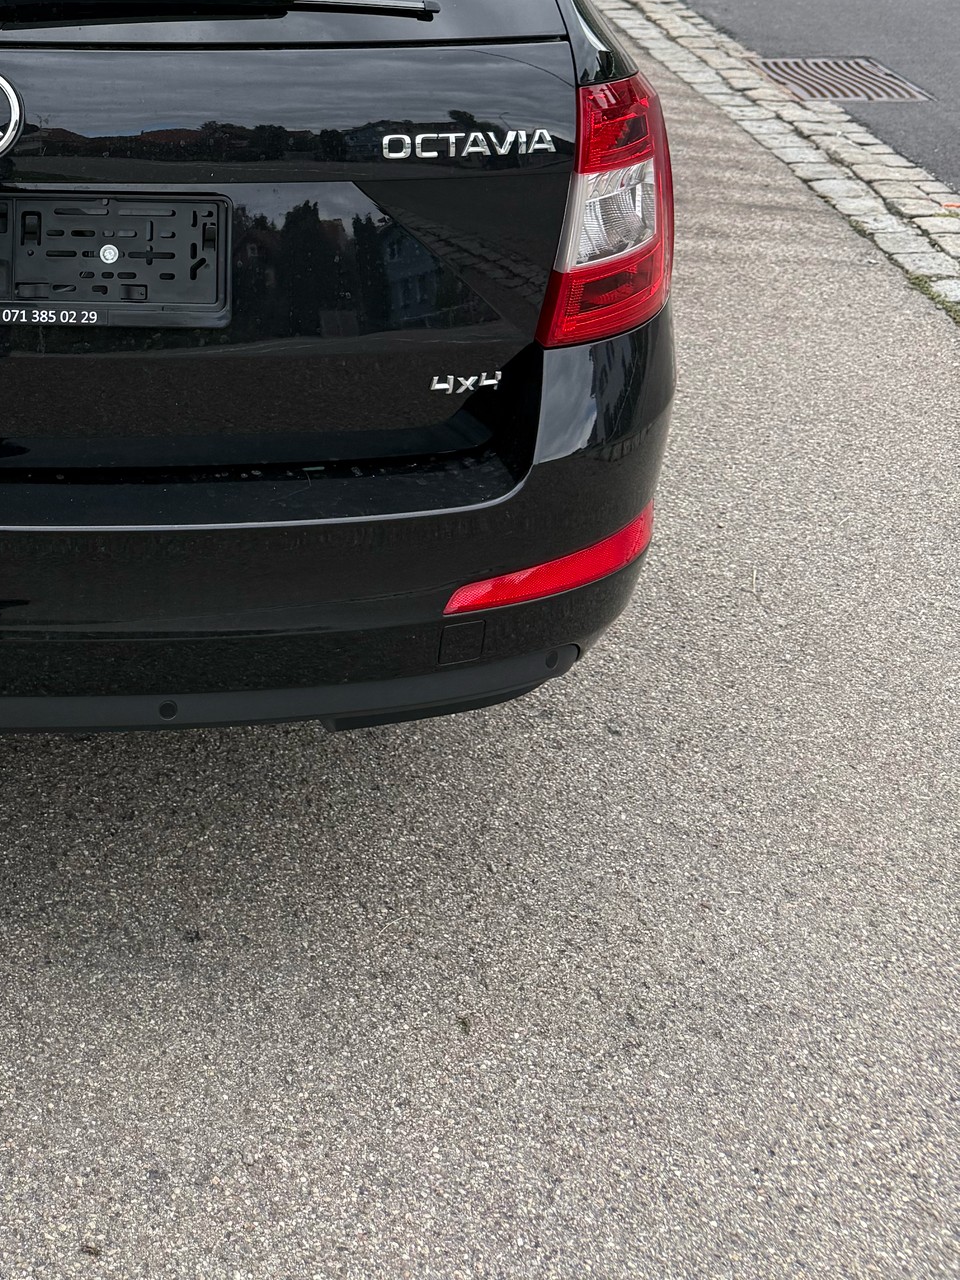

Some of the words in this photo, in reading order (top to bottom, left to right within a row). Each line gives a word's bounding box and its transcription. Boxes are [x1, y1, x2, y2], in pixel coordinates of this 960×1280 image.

[382, 128, 557, 160] OCTAVIA
[2, 309, 28, 322] 071
[31, 310, 57, 323] 385
[59, 311, 77, 324] 02
[81, 311, 98, 324] 29
[430, 370, 502, 395] 4x4
